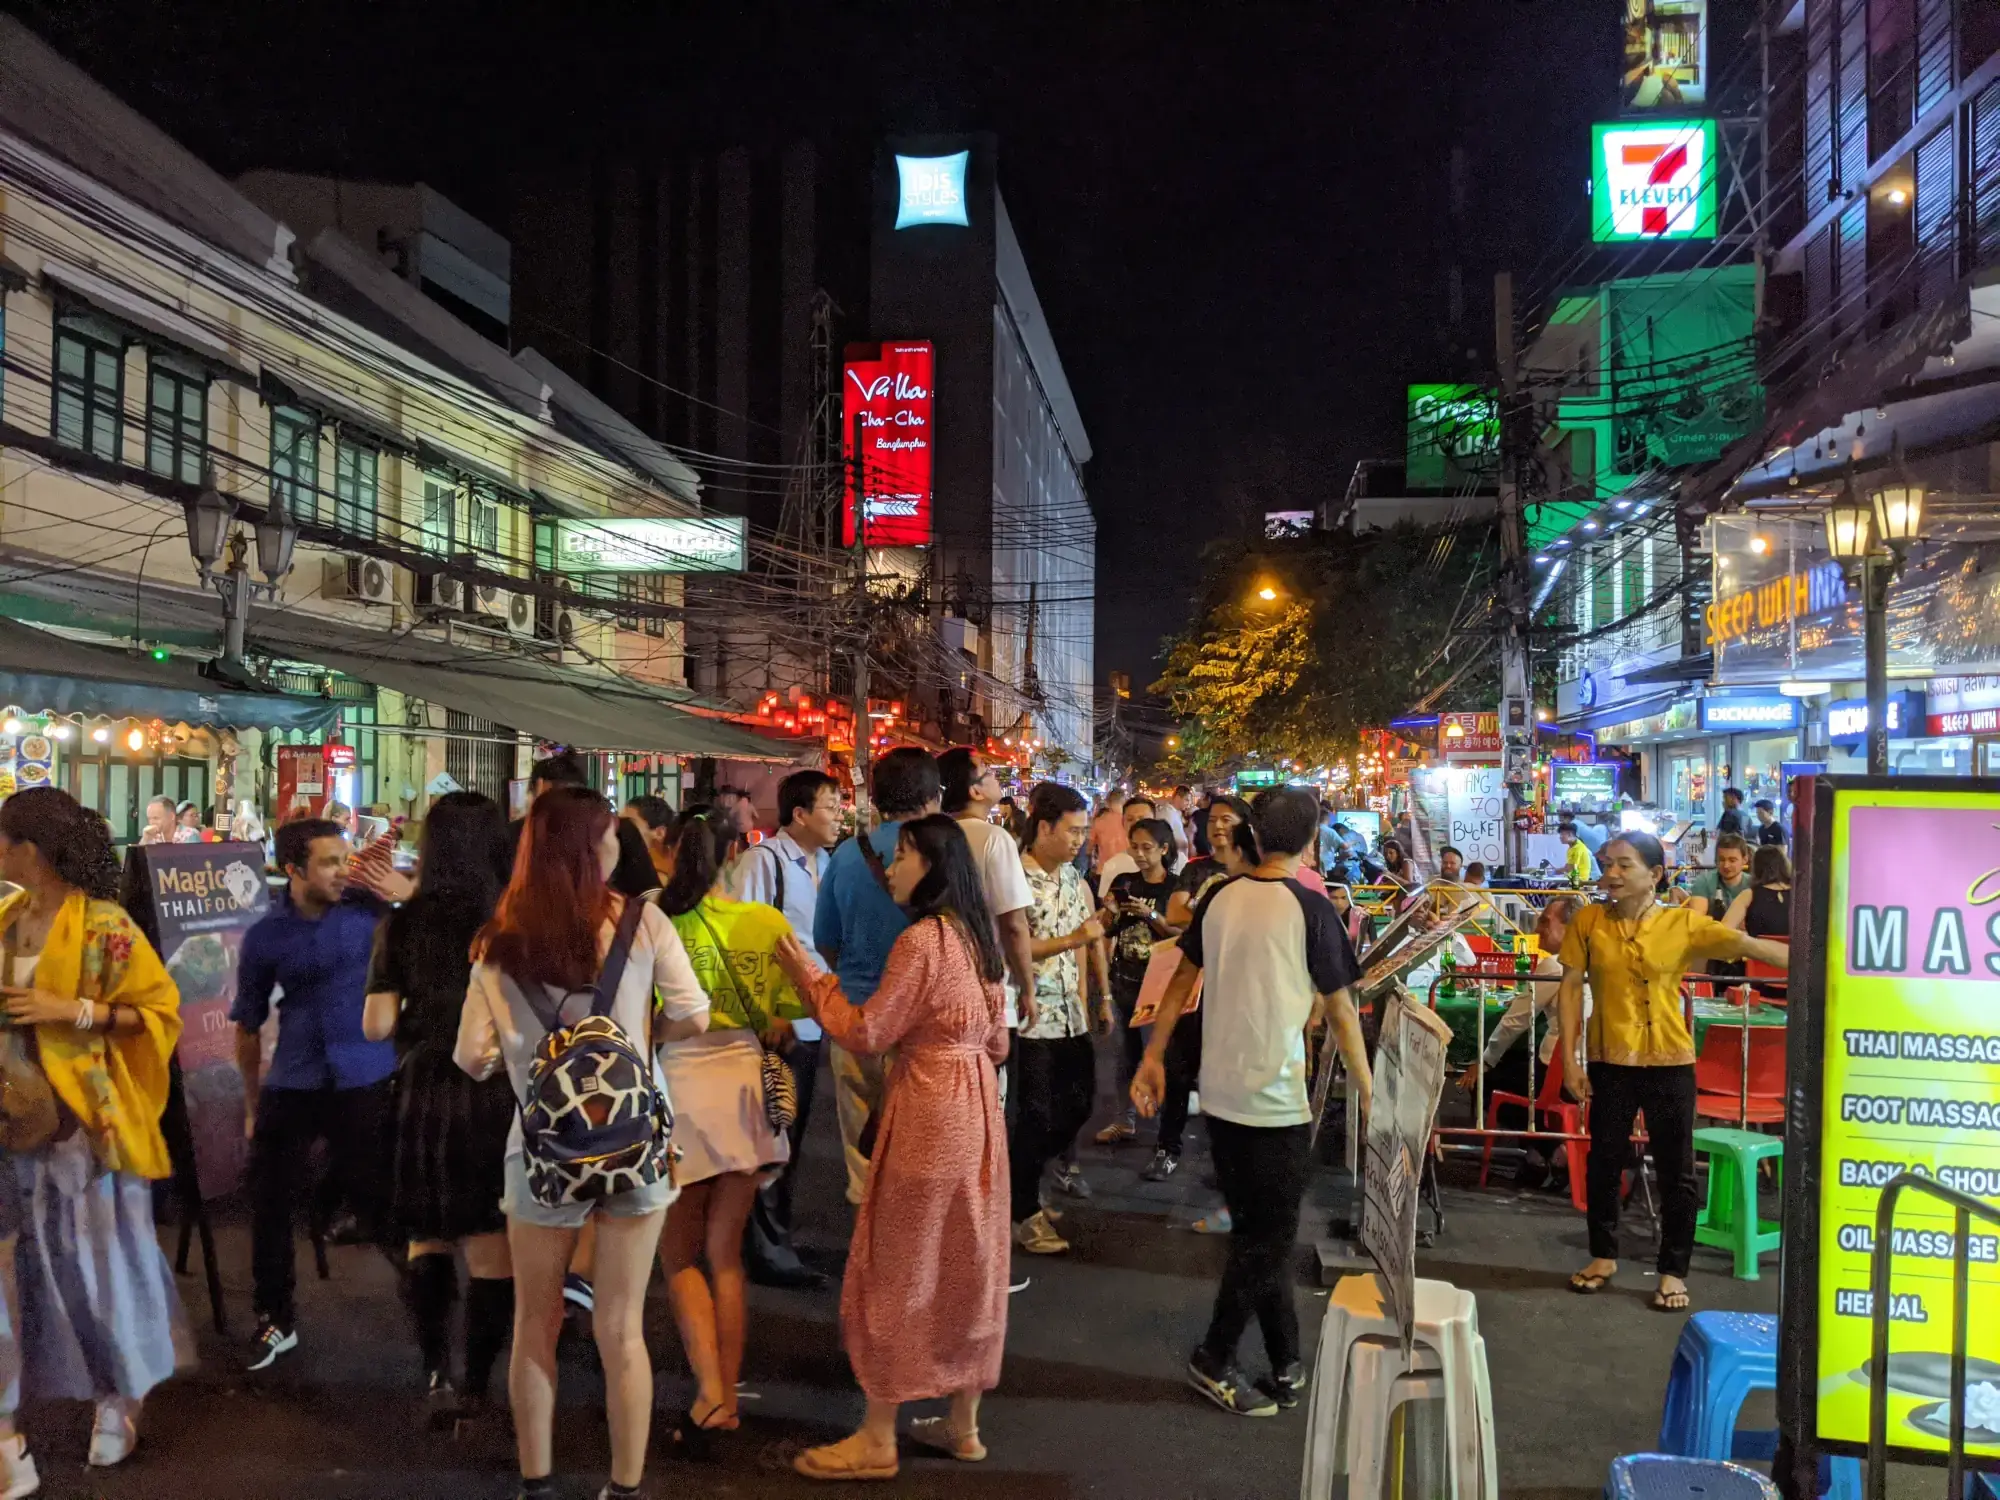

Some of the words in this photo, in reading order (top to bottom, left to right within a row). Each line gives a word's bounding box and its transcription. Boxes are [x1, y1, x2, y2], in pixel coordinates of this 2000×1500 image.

[1621, 143, 1688, 233] 7
[847, 369, 927, 402] Villa
[876, 437, 926, 452] Banglumphu
[1707, 702, 1793, 721] EXCHANGE
[1828, 702, 1898, 735] EXCHE
[1941, 713, 1970, 733] SLEEP
[1470, 797, 1500, 818] 70
[1453, 818, 1504, 842] BUCKET
[1466, 843, 1500, 862] 90
[156, 860, 226, 898] Magic
[1844, 1030, 1899, 1057] THAI
[1841, 1094, 1904, 1124] FOOT
[1838, 1224, 1875, 1251] OIL
